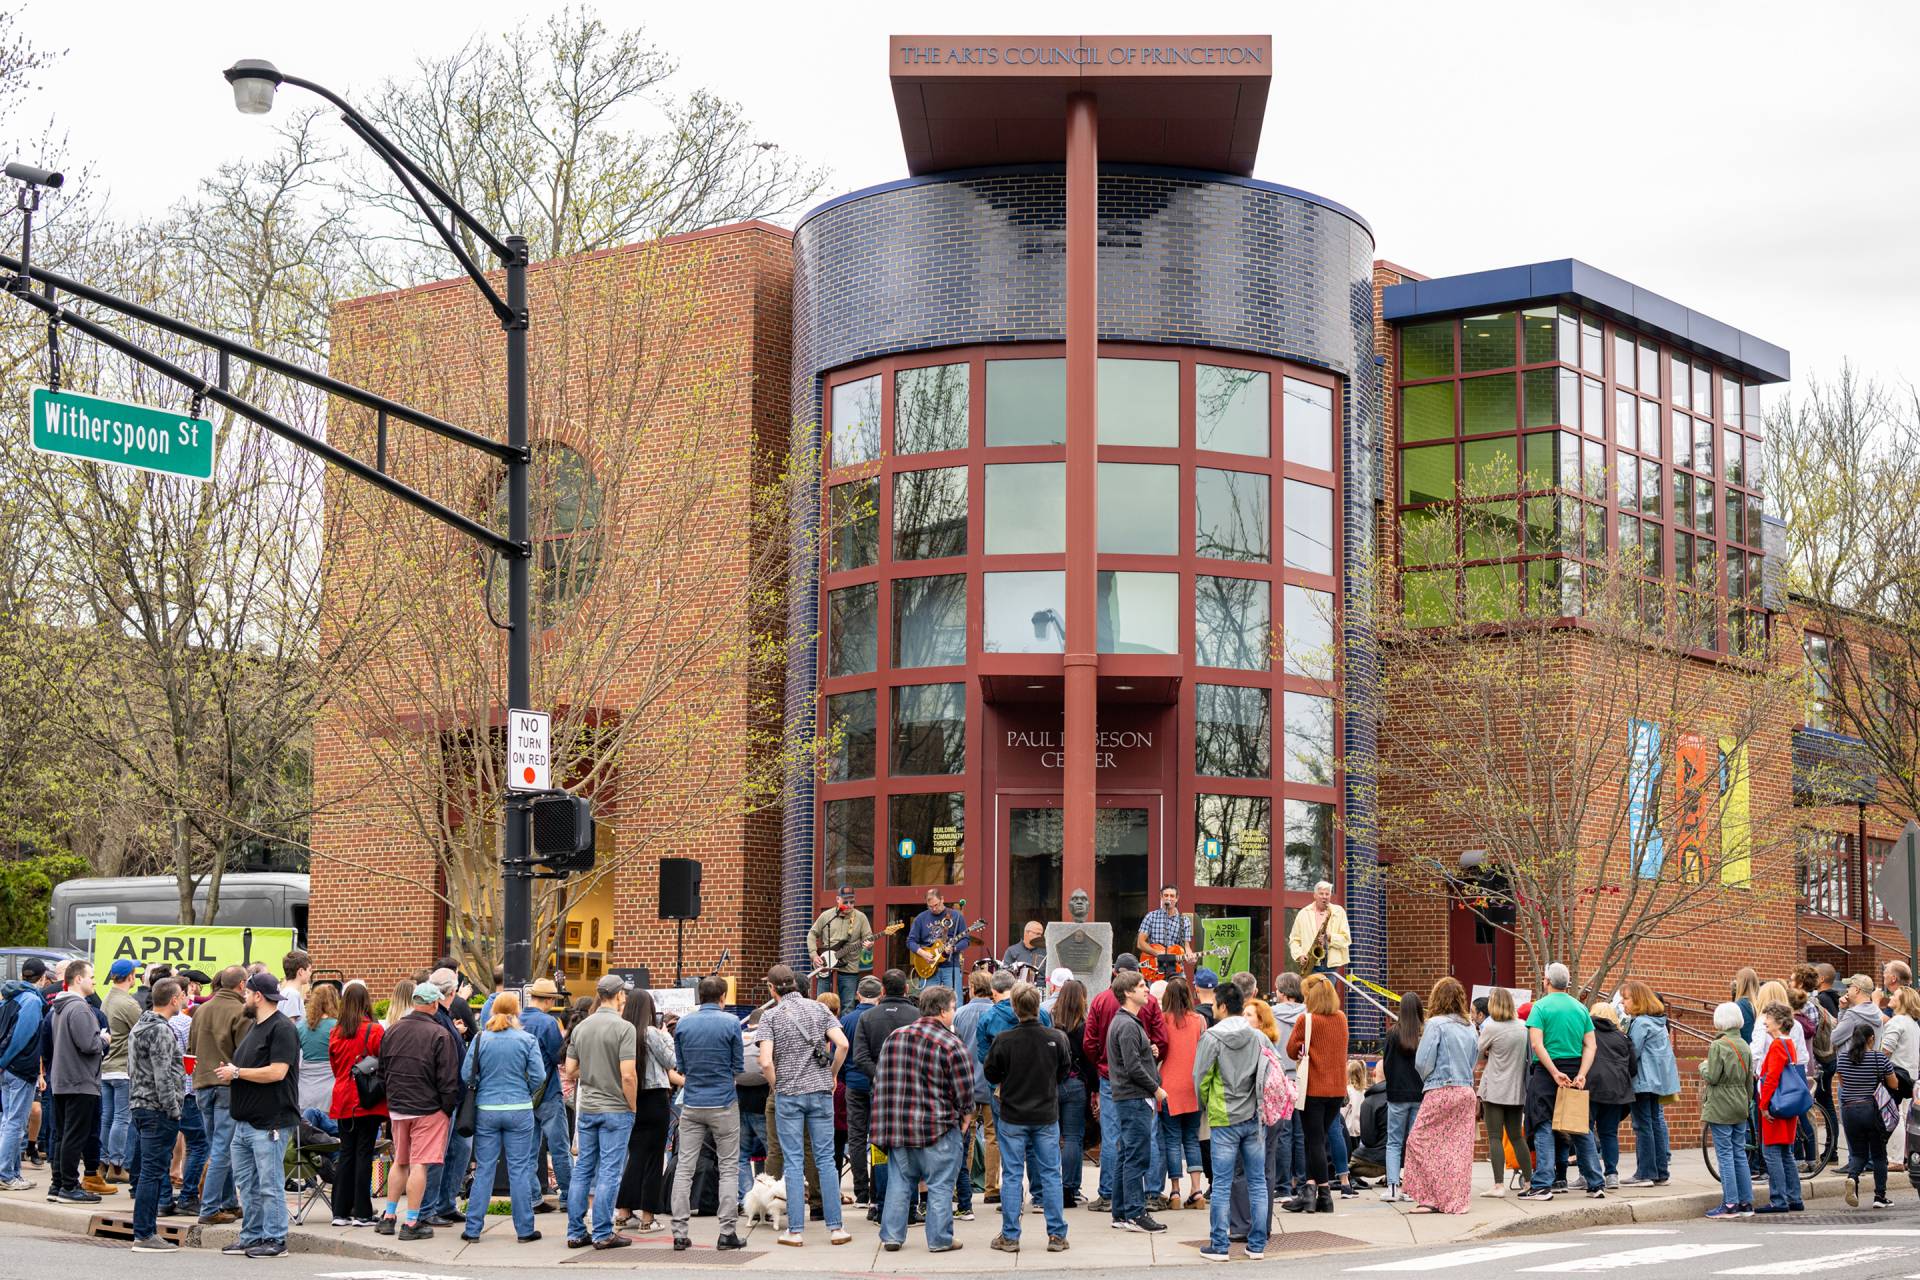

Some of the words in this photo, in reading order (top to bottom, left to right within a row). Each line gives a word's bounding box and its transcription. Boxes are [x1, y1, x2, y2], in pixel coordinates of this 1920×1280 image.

[901, 47, 940, 64] THE
[945, 47, 999, 64] ARTS
[1004, 47, 1103, 65] COUNCIL
[1108, 47, 1137, 65] OF
[1141, 47, 1262, 65] PRINCETON
[45, 401, 169, 454] Witherspoon
[178, 421, 199, 447] St
[520, 717, 539, 733] NO
[518, 736, 541, 749] TURN
[1007, 731, 1055, 747] PAUL
[1060, 731, 1152, 748] ESON
[513, 752, 525, 764] ON
[528, 754, 546, 766] RED
[1041, 752, 1117, 768] CEER
[113, 935, 217, 962] APRIL
